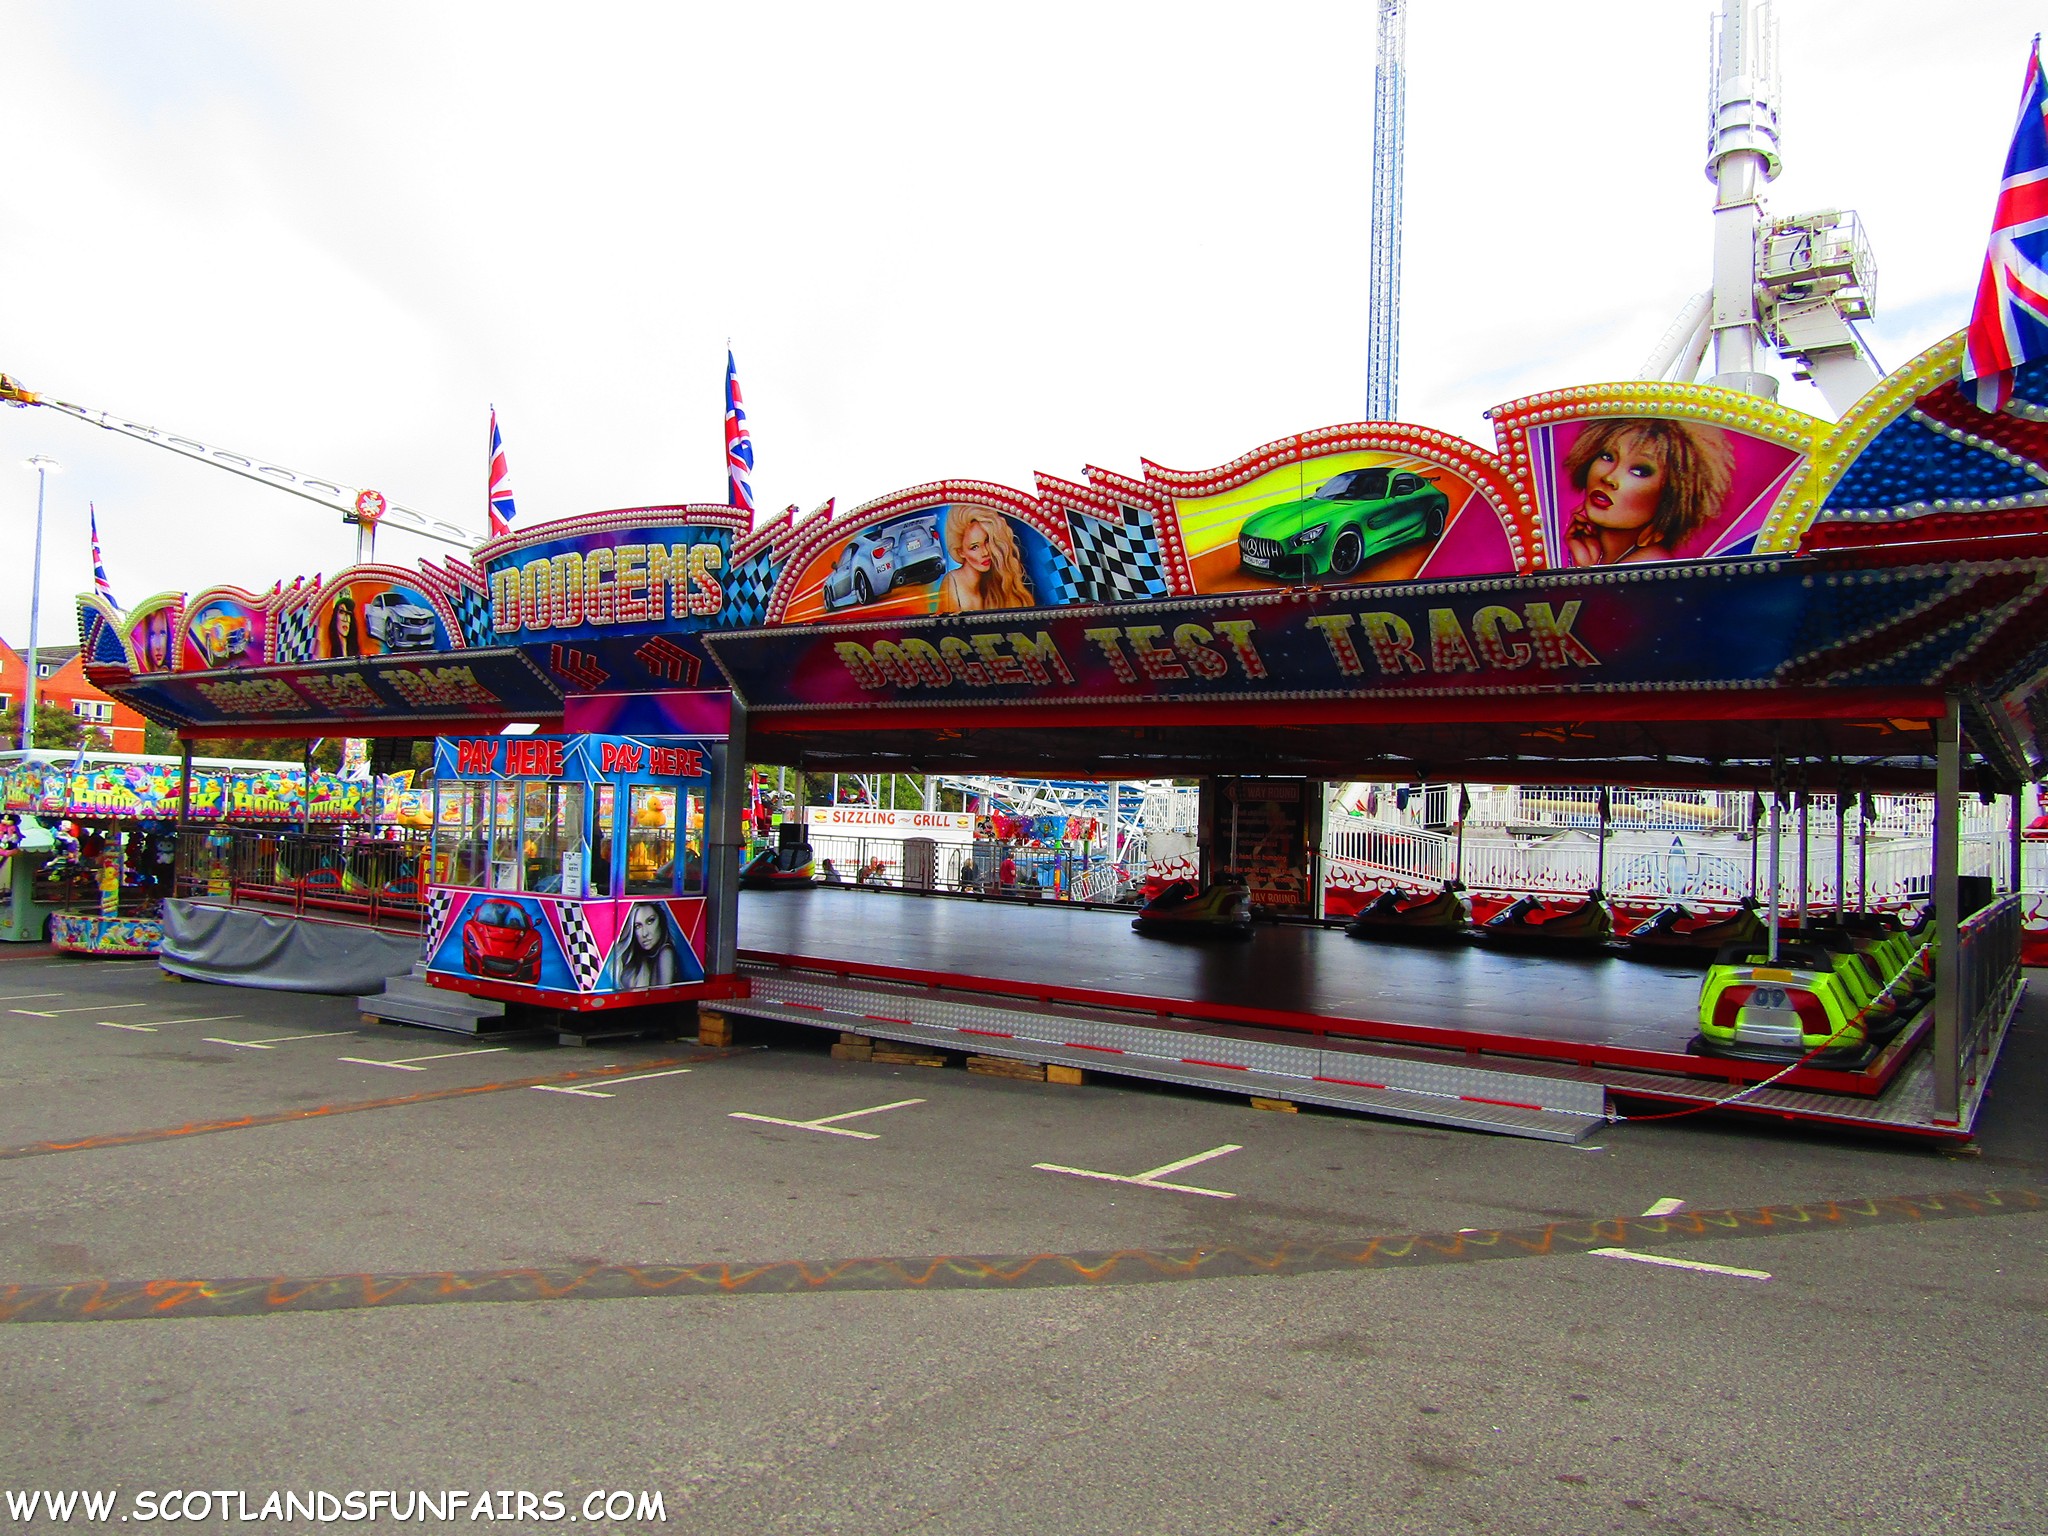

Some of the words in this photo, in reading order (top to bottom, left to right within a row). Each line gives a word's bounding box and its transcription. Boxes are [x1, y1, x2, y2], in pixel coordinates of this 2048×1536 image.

[491, 543, 723, 634] DODGEMS
[833, 629, 1076, 690] DODGEM
[1084, 618, 1270, 685] TEST
[1303, 599, 1602, 677] TRACK
[457, 739, 498, 775] PAY
[505, 739, 564, 776] HERE
[600, 742, 643, 773] PAY
[649, 745, 703, 777] HERE
[69, 788, 135, 815] HOOK
[141, 800, 155, 815] A
[231, 792, 292, 817] HOOK
[309, 797, 361, 819] DUCK
[832, 810, 896, 825] SIZZLING
[913, 814, 951, 827] GRILL
[1268, 894, 1297, 904] ROUND
[1753, 987, 1786, 1008] 09
